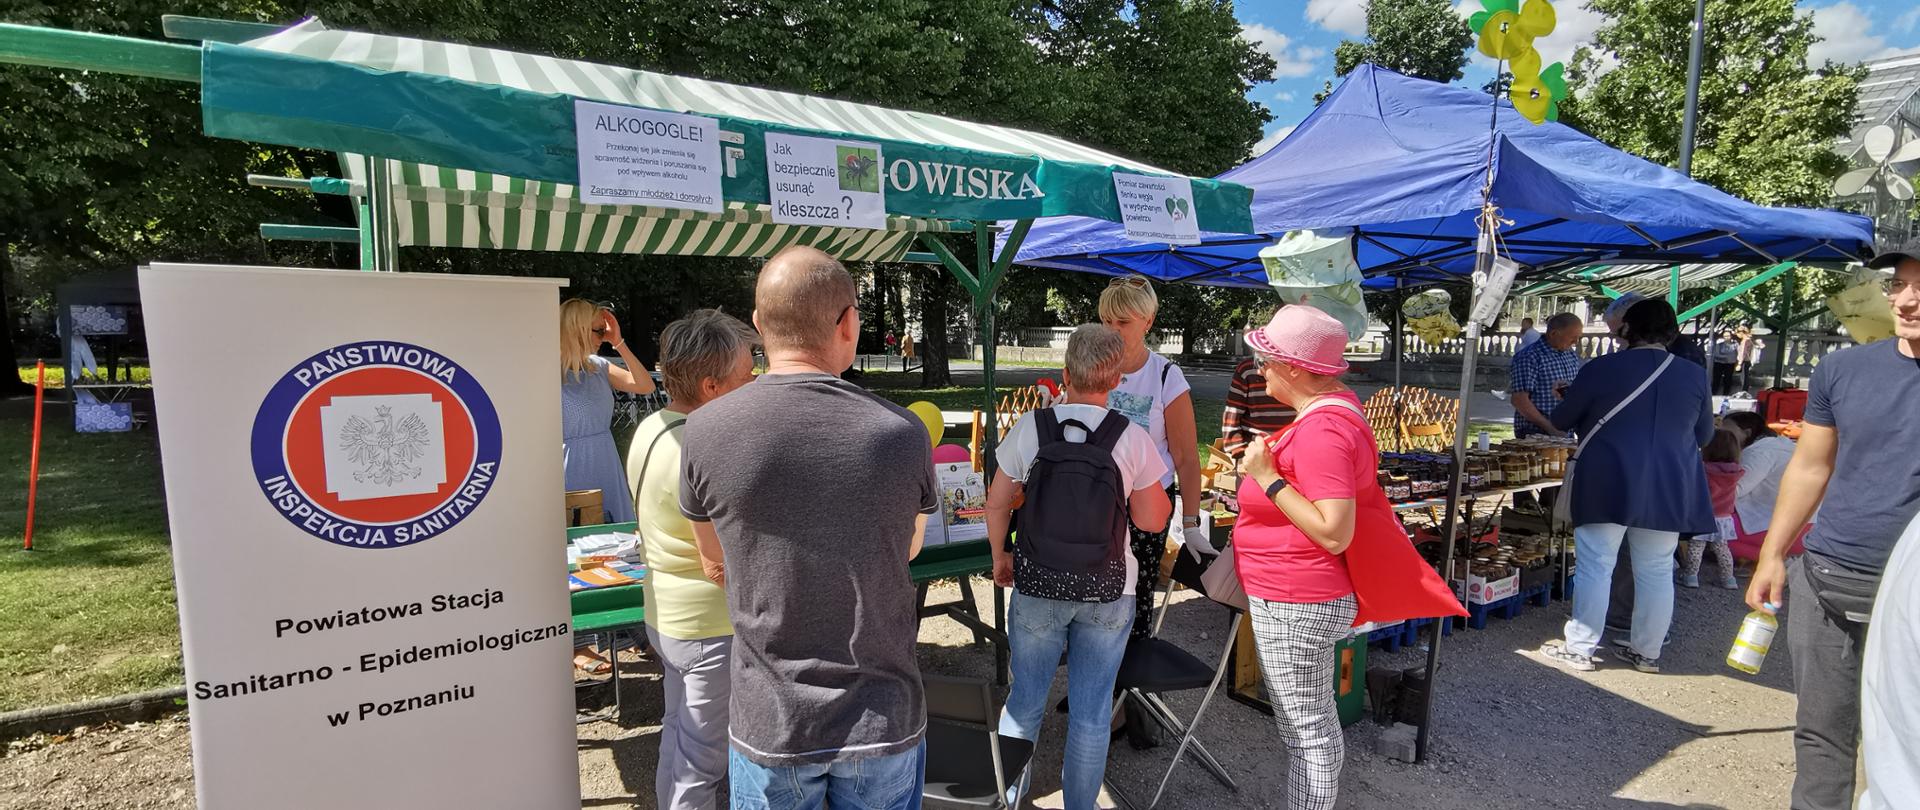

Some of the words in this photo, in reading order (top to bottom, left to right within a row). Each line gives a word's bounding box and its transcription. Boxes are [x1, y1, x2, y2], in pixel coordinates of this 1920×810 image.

[595, 115, 703, 142] ALKOGOGLE!
[606, 142, 640, 153] Przekonaj
[640, 146, 650, 154] się
[650, 147, 661, 155] jak
[661, 148, 686, 157] zmienia
[686, 152, 696, 160] się
[773, 142, 793, 156] Jak
[594, 155, 630, 164] sprawność
[631, 157, 660, 165] widzenia
[697, 165, 707, 173] się
[631, 168, 661, 177] wpływem
[662, 171, 688, 181] alkoholu
[774, 161, 836, 178] bezpiecznie
[775, 181, 815, 197] usunąć
[887, 157, 1046, 200] OWISKA
[590, 184, 639, 197] Zapraszamy
[640, 189, 674, 199] młodzież
[679, 192, 714, 205] dorosłych
[778, 199, 839, 220] kleszcza
[841, 195, 854, 220] ?
[294, 344, 457, 387] PAŃSTWOWA
[264, 475, 388, 545] INSPEKCJA
[394, 461, 496, 544] SANITARNA
[275, 602, 423, 638] Powiatowa
[431, 588, 504, 612] Stacja
[194, 665, 333, 700] Sanitarno
[360, 622, 569, 673] Epidemiologiczna
[327, 711, 350, 727] w
[359, 684, 475, 721] Poznaniu
